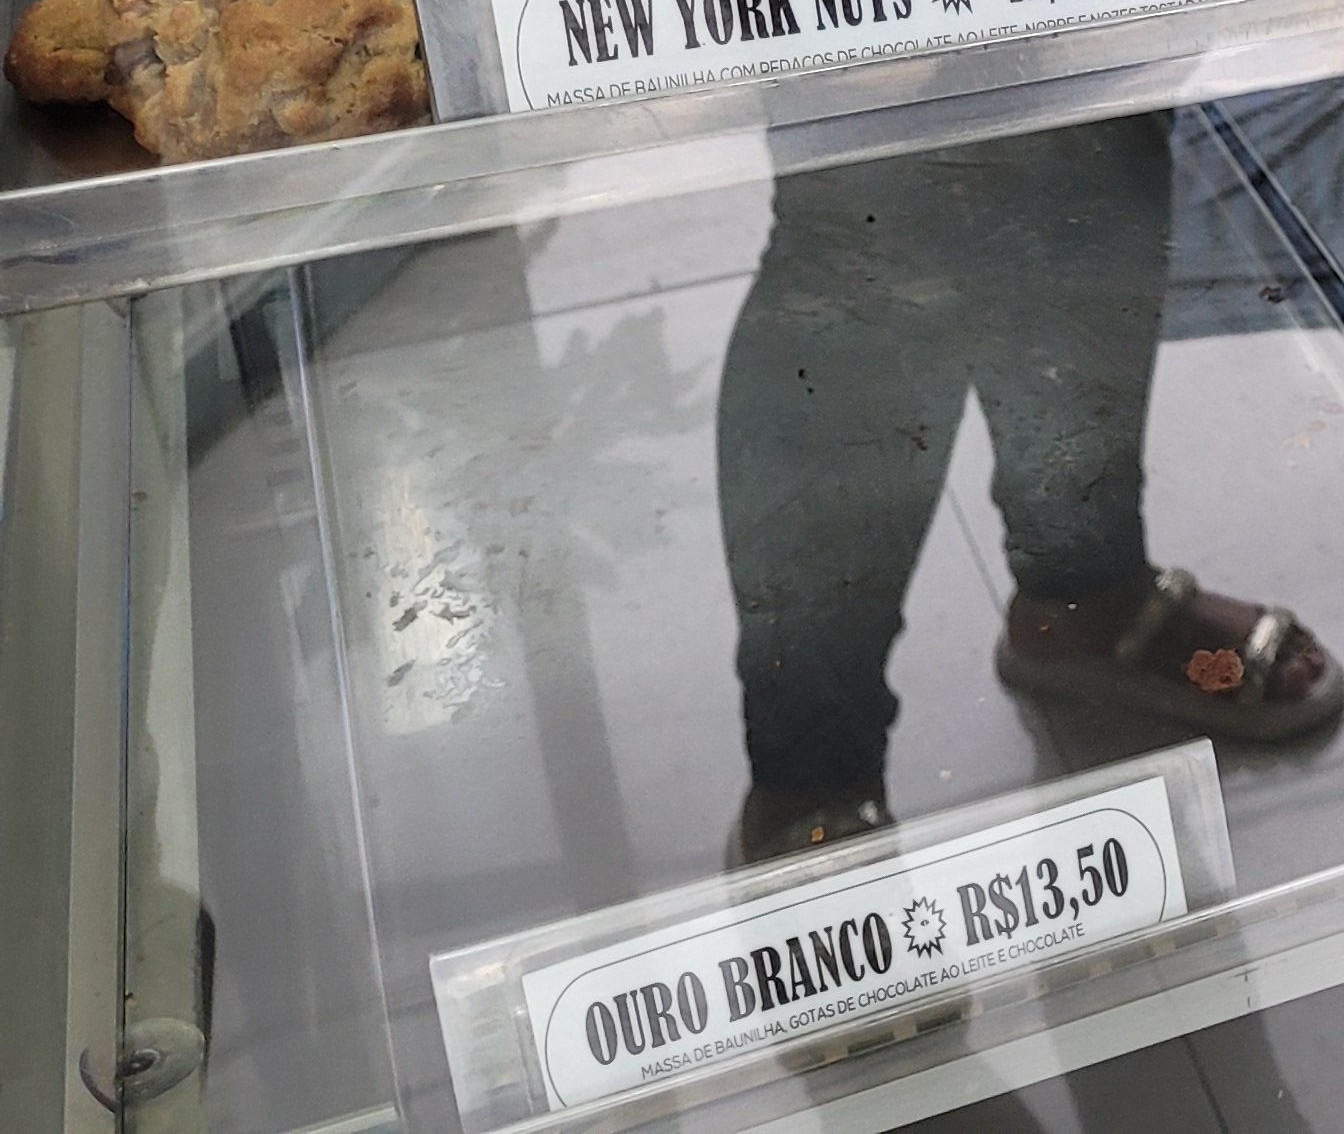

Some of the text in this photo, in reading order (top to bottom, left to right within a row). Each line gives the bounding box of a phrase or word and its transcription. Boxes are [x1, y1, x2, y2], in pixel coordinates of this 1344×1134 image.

[586, 835, 1128, 1067] OURO BRANCO R$13,50
[641, 1051, 691, 1080] MASSA
[694, 1043, 712, 1062] DE
[789, 1002, 835, 1030] GOTAS
[838, 996, 853, 1014] DE
[858, 969, 938, 1008] CHOCOLATE
[941, 962, 959, 981] AO
[963, 951, 995, 974] LEITE
[998, 947, 1006, 962] E
[1008, 922, 1084, 959] CHOCOLATE
